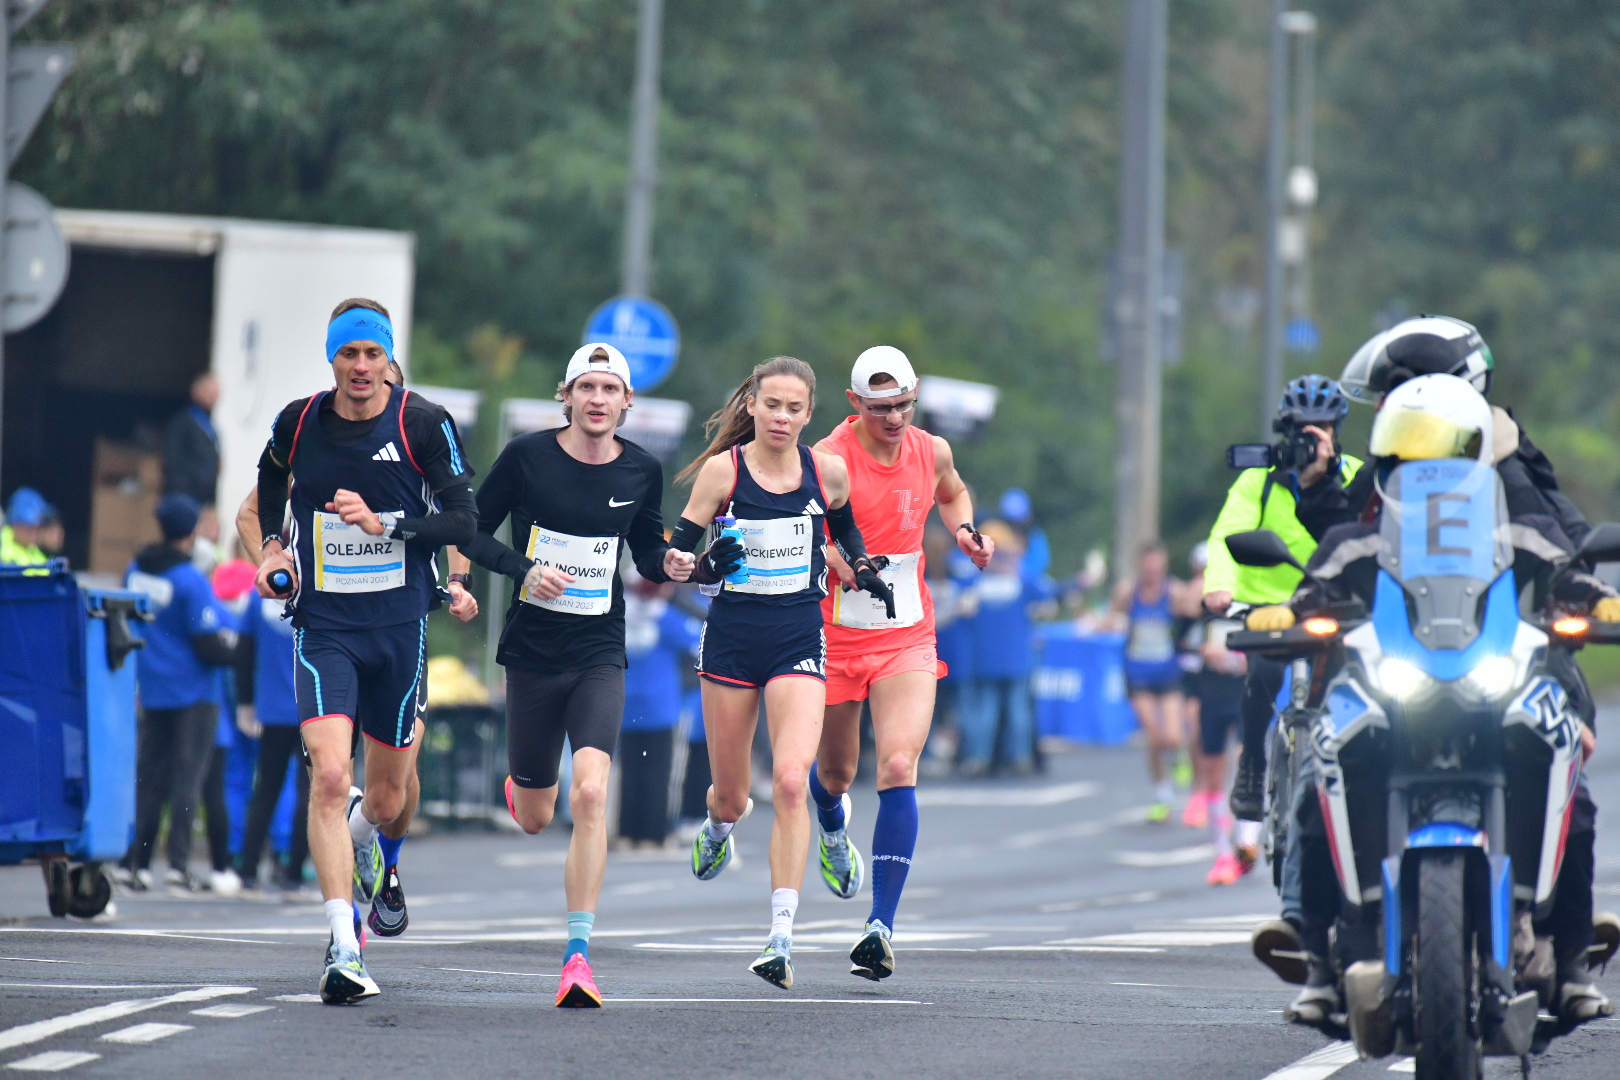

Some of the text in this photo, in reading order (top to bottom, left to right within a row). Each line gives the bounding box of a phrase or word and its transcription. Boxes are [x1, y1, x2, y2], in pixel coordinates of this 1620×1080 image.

[324, 521, 334, 530] 22
[793, 523, 805, 536] 11
[1426, 491, 1473, 557] E
[539, 534, 551, 545] 22
[325, 541, 393, 556] OLEJARZ
[593, 541, 609, 555] 49
[744, 545, 805, 559] ACKIEWICZ
[370, 575, 389, 584] 2023
[779, 578, 797, 587] 2023
[545, 598, 594, 610] OZNAŃ 2023
